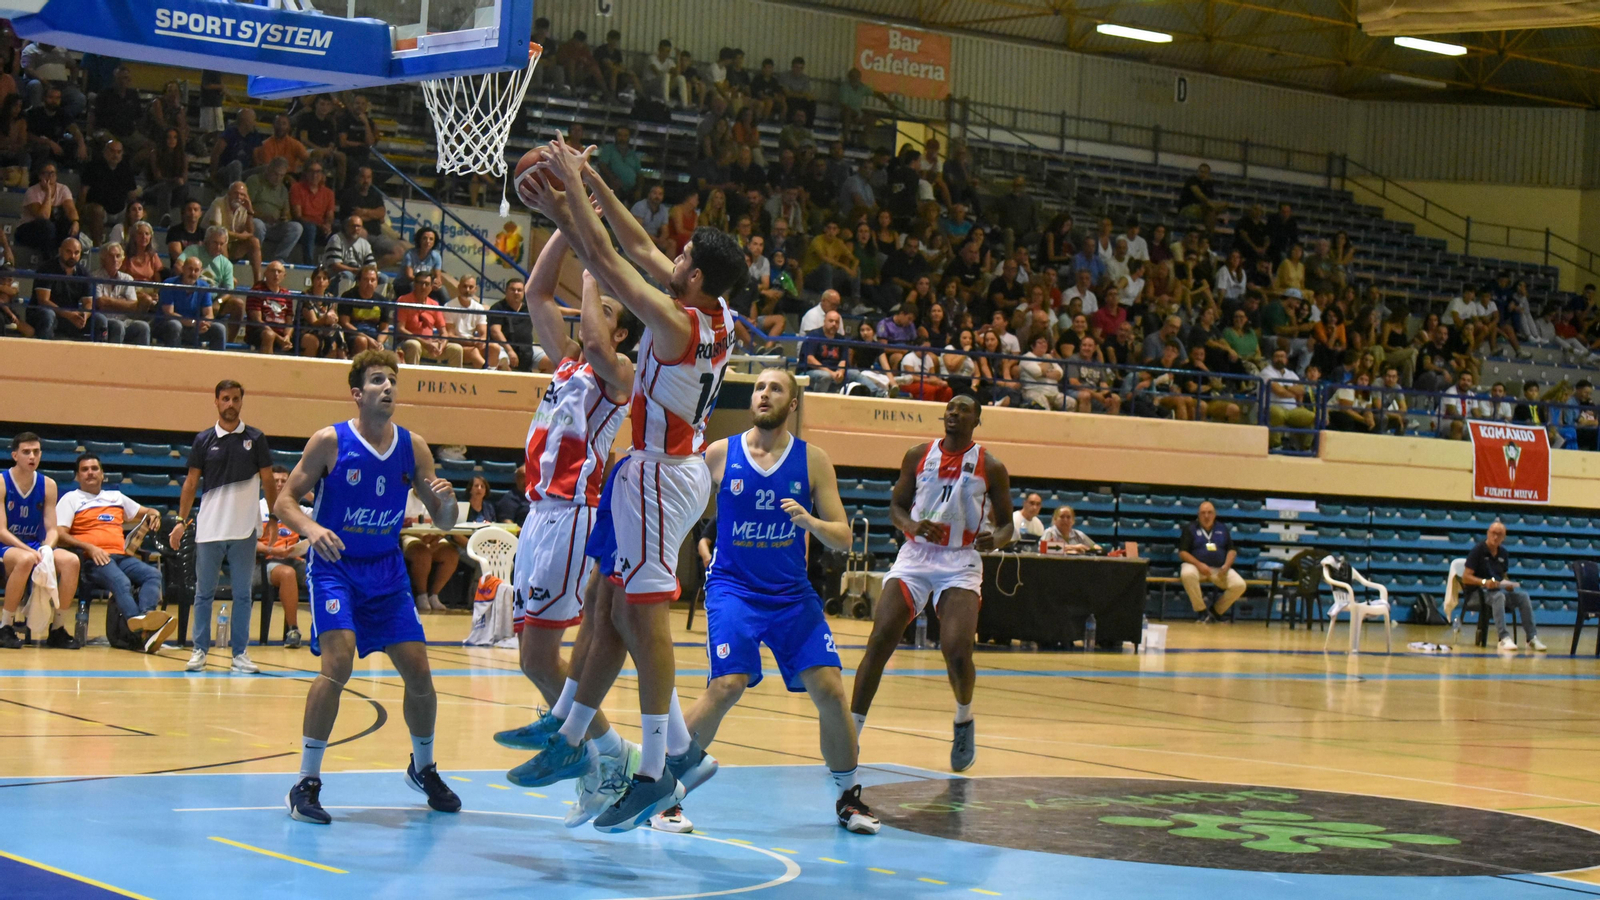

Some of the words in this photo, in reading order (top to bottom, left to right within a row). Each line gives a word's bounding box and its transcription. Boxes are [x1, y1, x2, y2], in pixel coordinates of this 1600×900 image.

[155, 8, 236, 37] SPORT
[237, 20, 333, 48] SYSTEM
[888, 29, 922, 53] Bar
[860, 48, 945, 81] Cafetería
[1177, 77, 1187, 102] D
[417, 380, 477, 395] PRENSA
[874, 409, 922, 423] PRENSA
[1479, 425, 1536, 442] KOMANDO
[375, 475, 386, 497] 6
[941, 485, 953, 503] 11
[755, 489, 776, 510] 22
[19, 505, 29, 518] 10
[732, 521, 796, 540] MELILLA
[512, 588, 525, 610] 4
